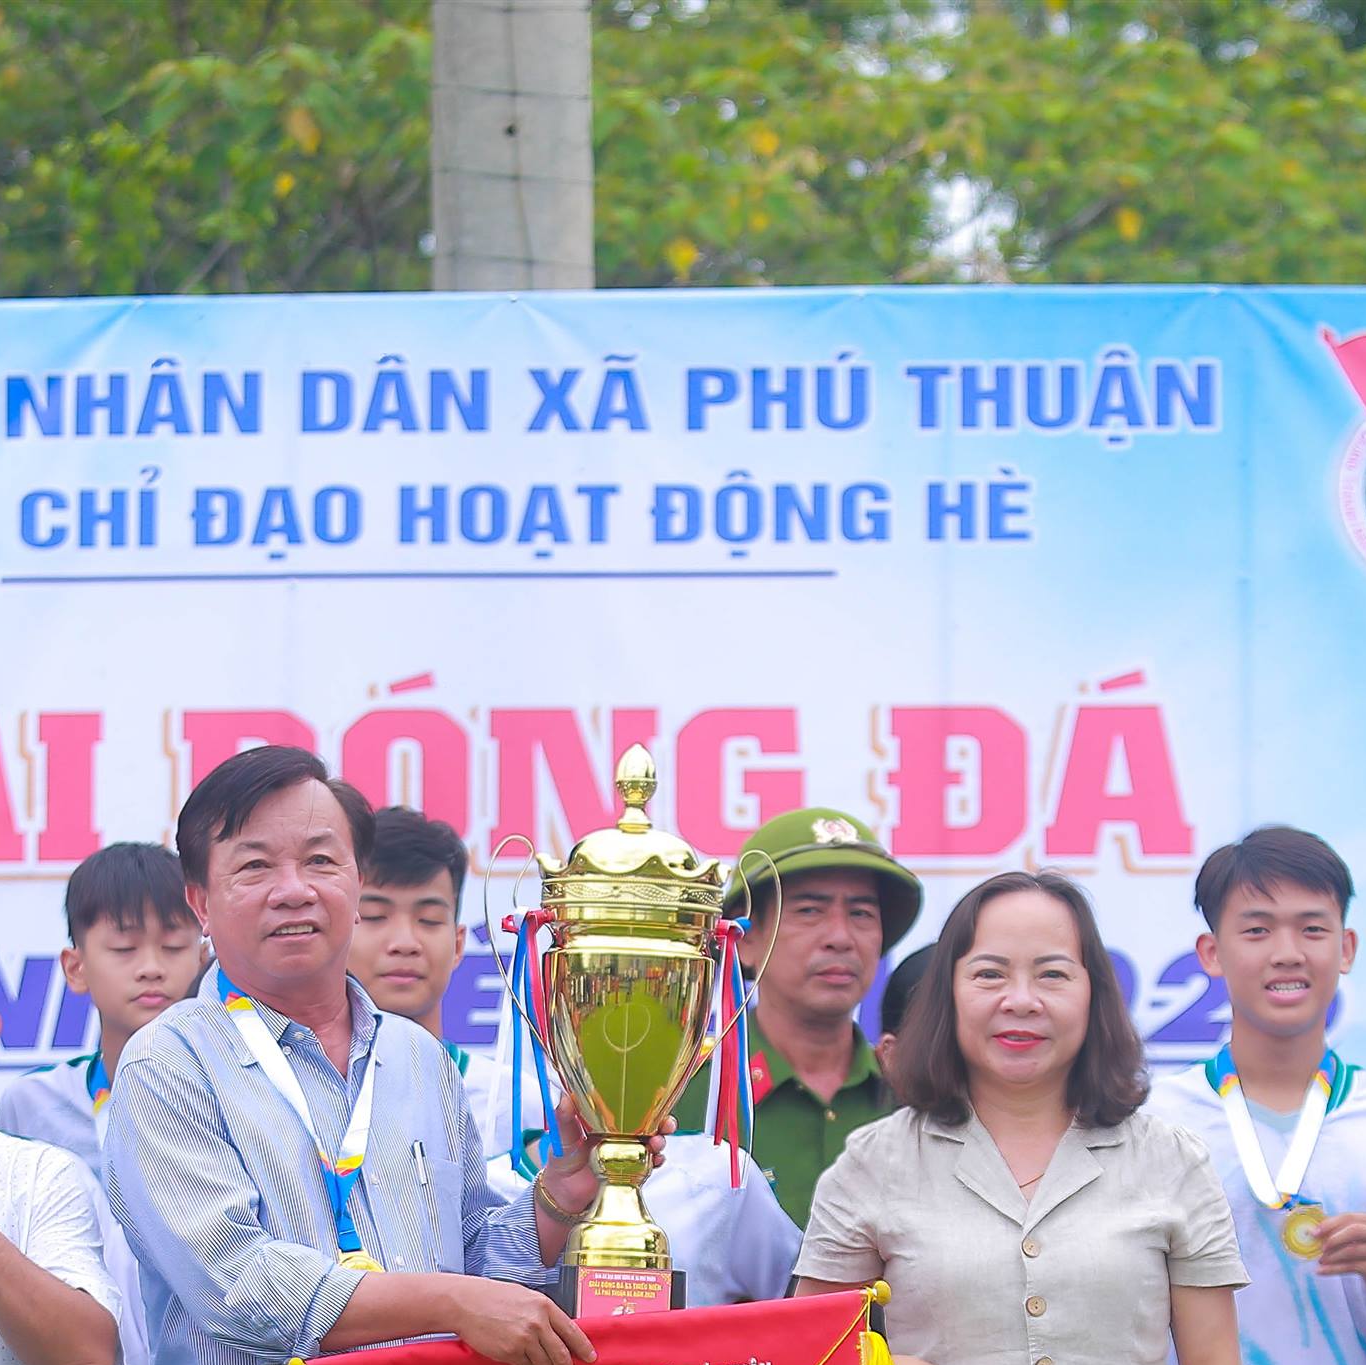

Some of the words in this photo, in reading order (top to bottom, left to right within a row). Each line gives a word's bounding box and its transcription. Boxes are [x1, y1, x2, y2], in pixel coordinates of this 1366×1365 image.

[5, 356, 262, 437] NHÂN
[300, 354, 490, 433] DÂN
[528, 355, 648, 432] XÃ
[685, 351, 871, 432] PHÚ
[906, 351, 1216, 444] THUẬN
[19, 467, 159, 548] CHỈ
[191, 484, 361, 560] ĐẠO
[398, 484, 620, 558] HOẠT
[651, 470, 891, 558] ĐỘNG
[927, 467, 1032, 541] HÈ
[887, 668, 1193, 856] ĐÁ
